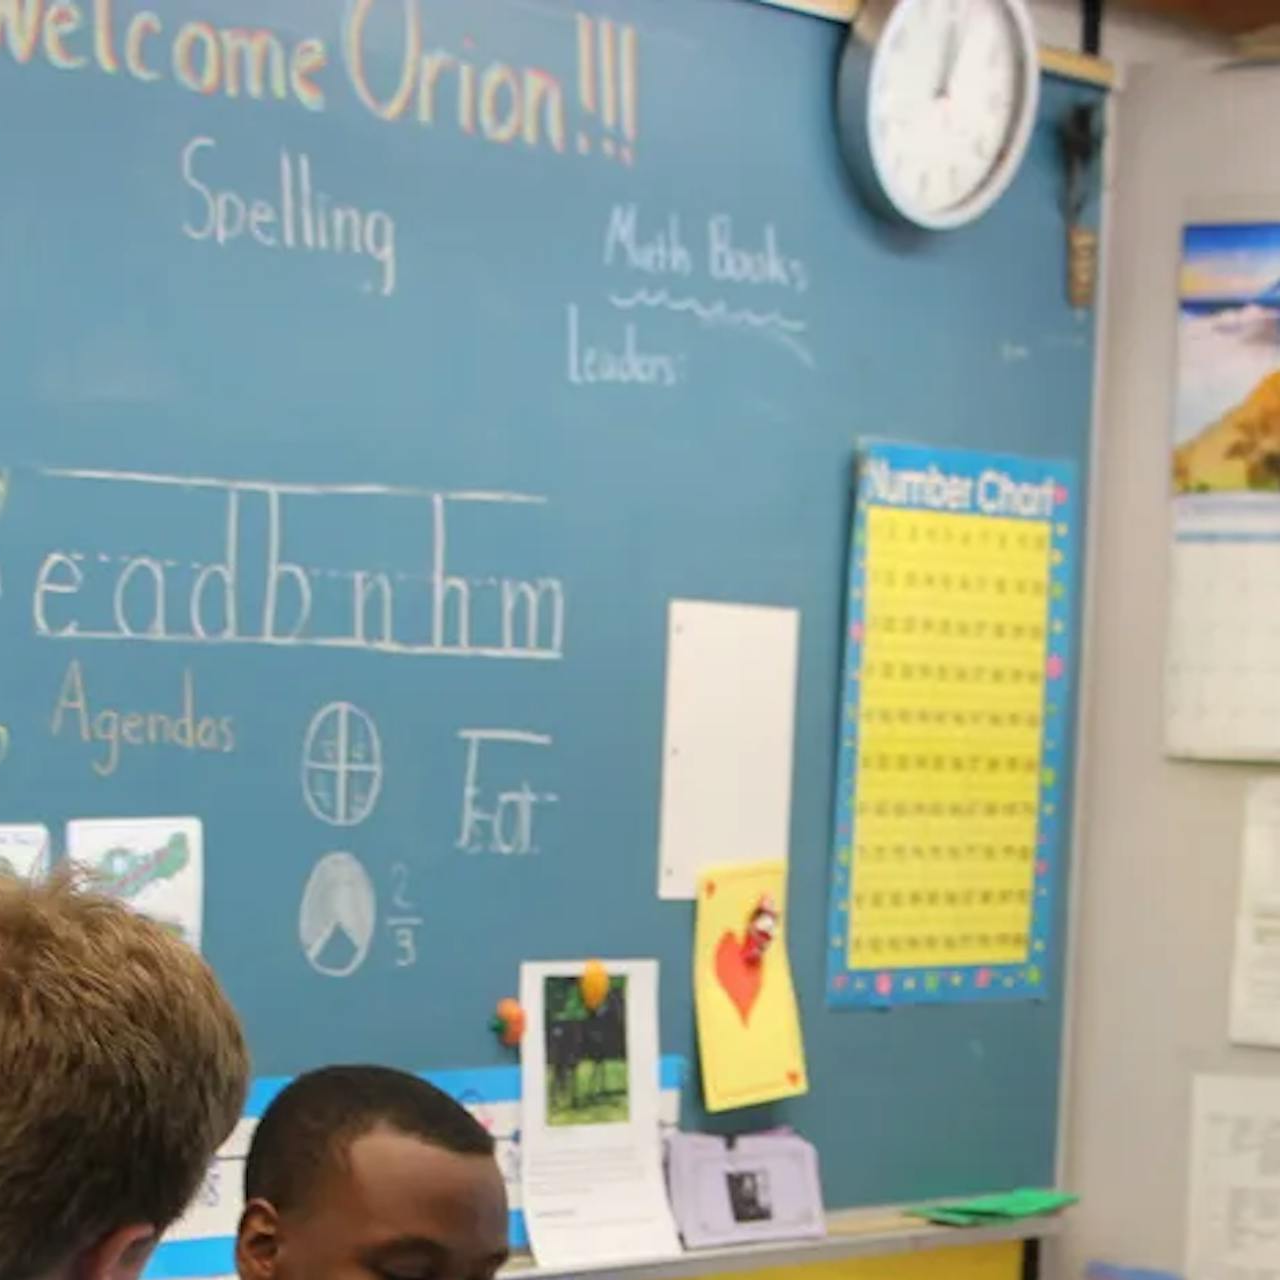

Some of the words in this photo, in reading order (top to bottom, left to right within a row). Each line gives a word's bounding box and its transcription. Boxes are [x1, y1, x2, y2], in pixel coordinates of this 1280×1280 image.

[343, 0, 638, 166] Orion!!!
[180, 135, 396, 296] Spelling
[602, 202, 693, 279] Math
[708, 212, 810, 296] Books
[866, 456, 973, 509] Number
[976, 467, 1056, 517] Chart
[50, 658, 236, 777] Agendas
